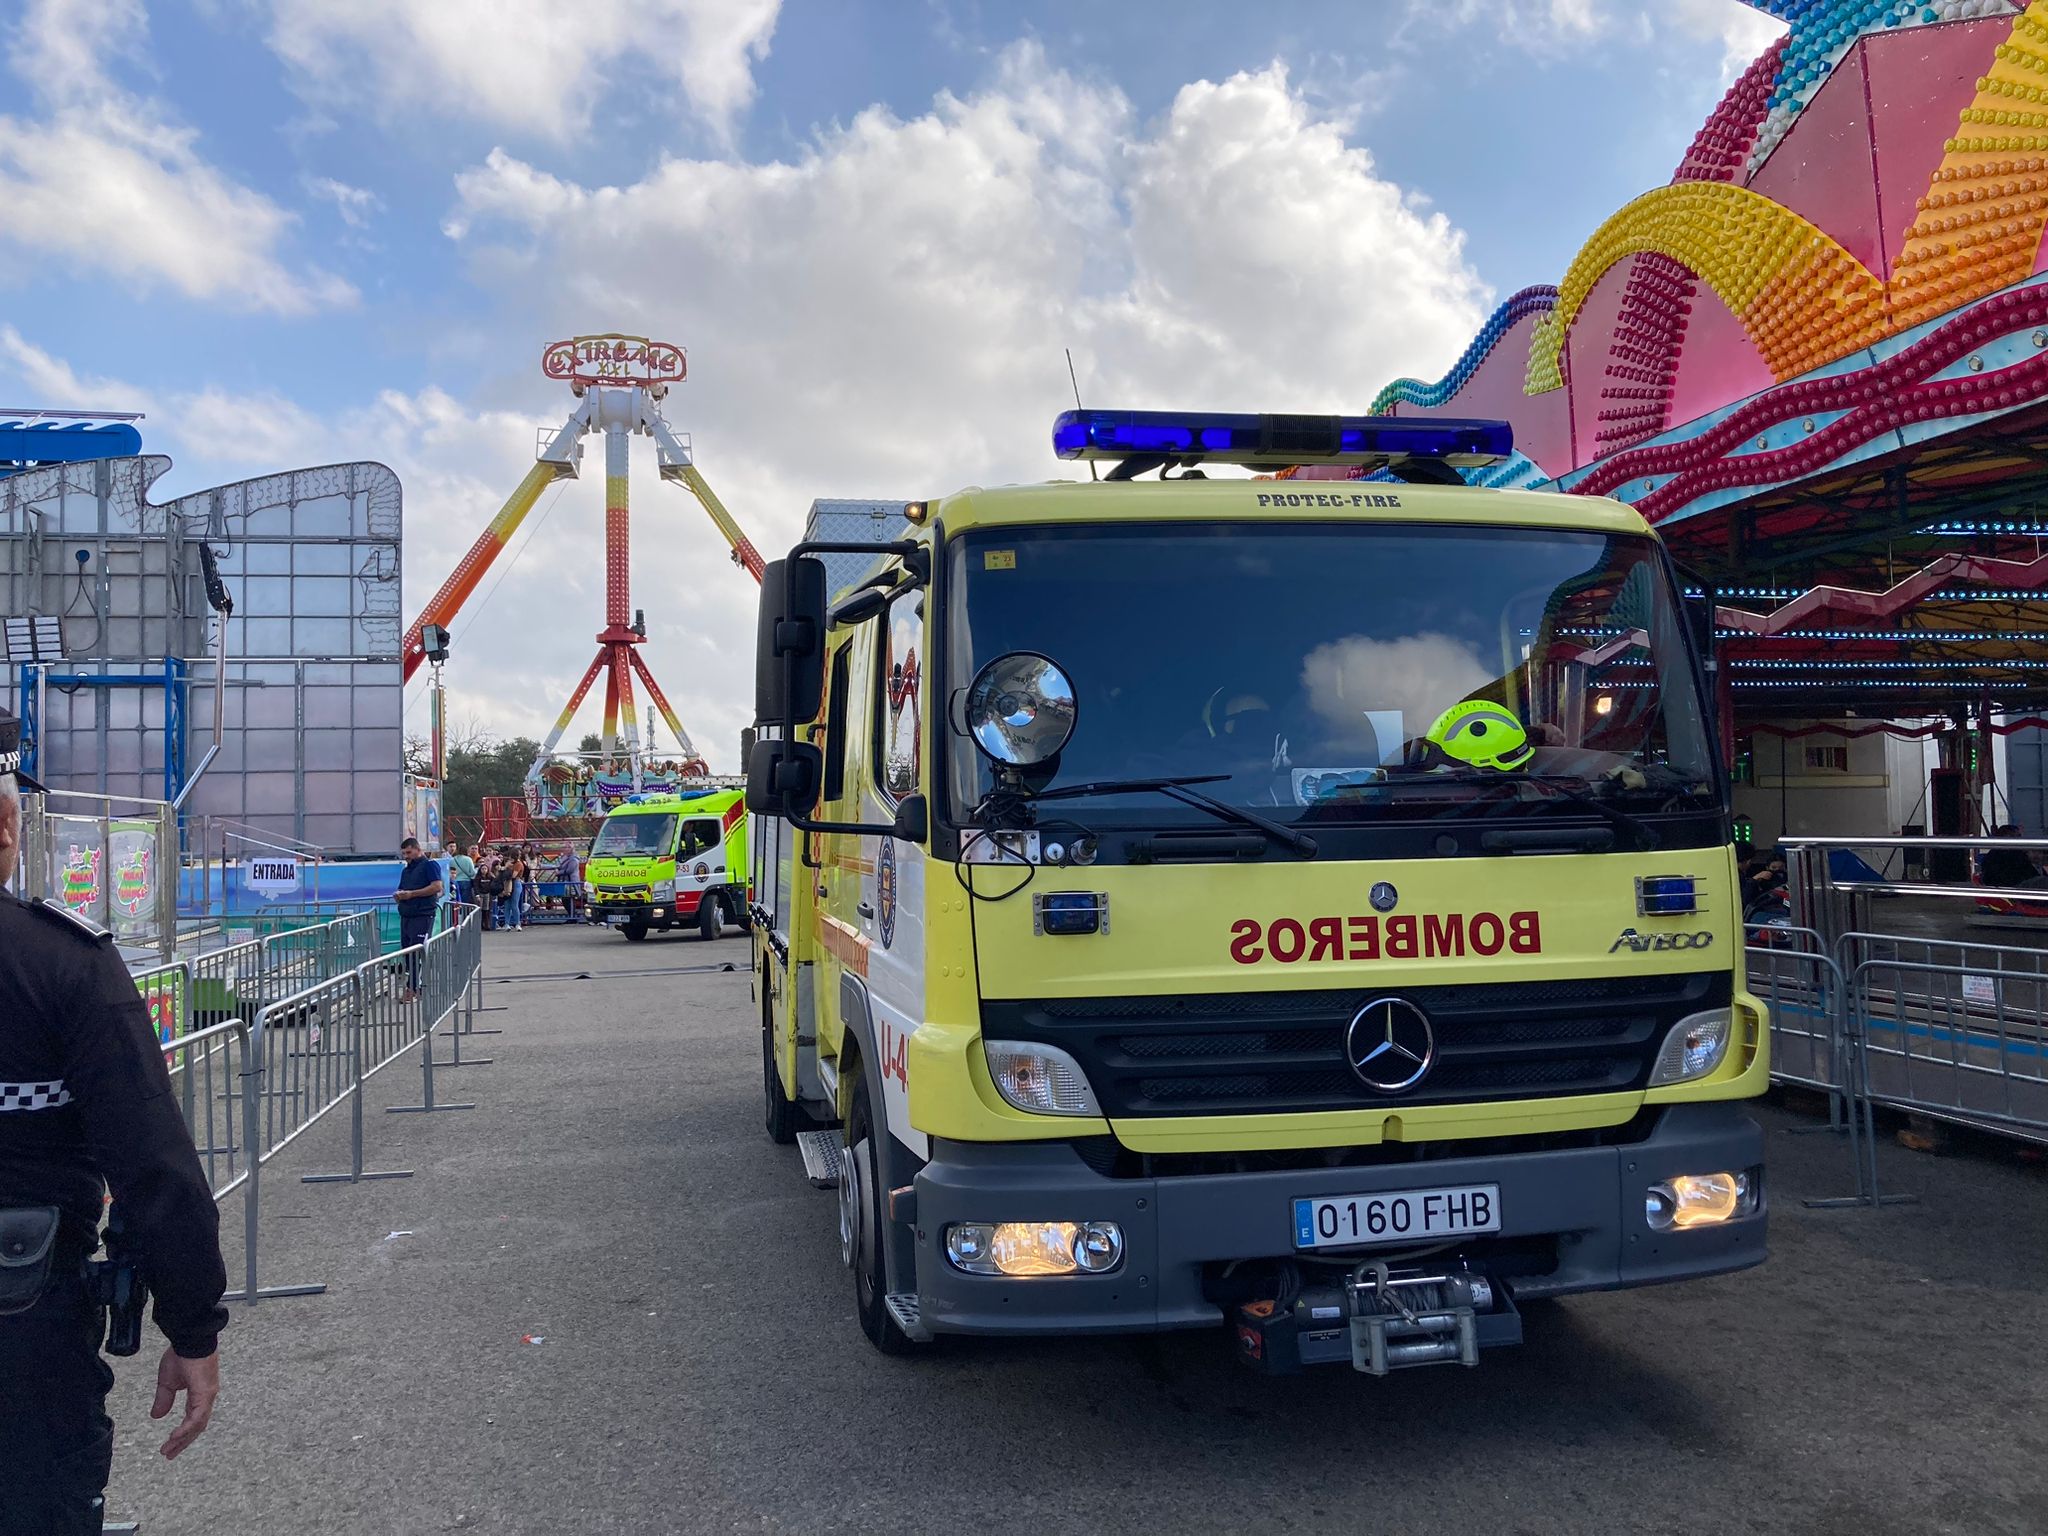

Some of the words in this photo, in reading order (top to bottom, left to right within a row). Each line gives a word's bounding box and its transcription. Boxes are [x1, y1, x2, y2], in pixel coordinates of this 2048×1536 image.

[548, 341, 678, 373] EXTREME
[597, 361, 631, 375] XXL
[1257, 493, 1402, 508] PROTEC-FIRE
[253, 864, 295, 880] ENTRADA
[880, 1020, 909, 1093] U-4
[1318, 1198, 1411, 1239] 0160
[1423, 1191, 1491, 1231] FHB
[1302, 1227, 1310, 1238] E
